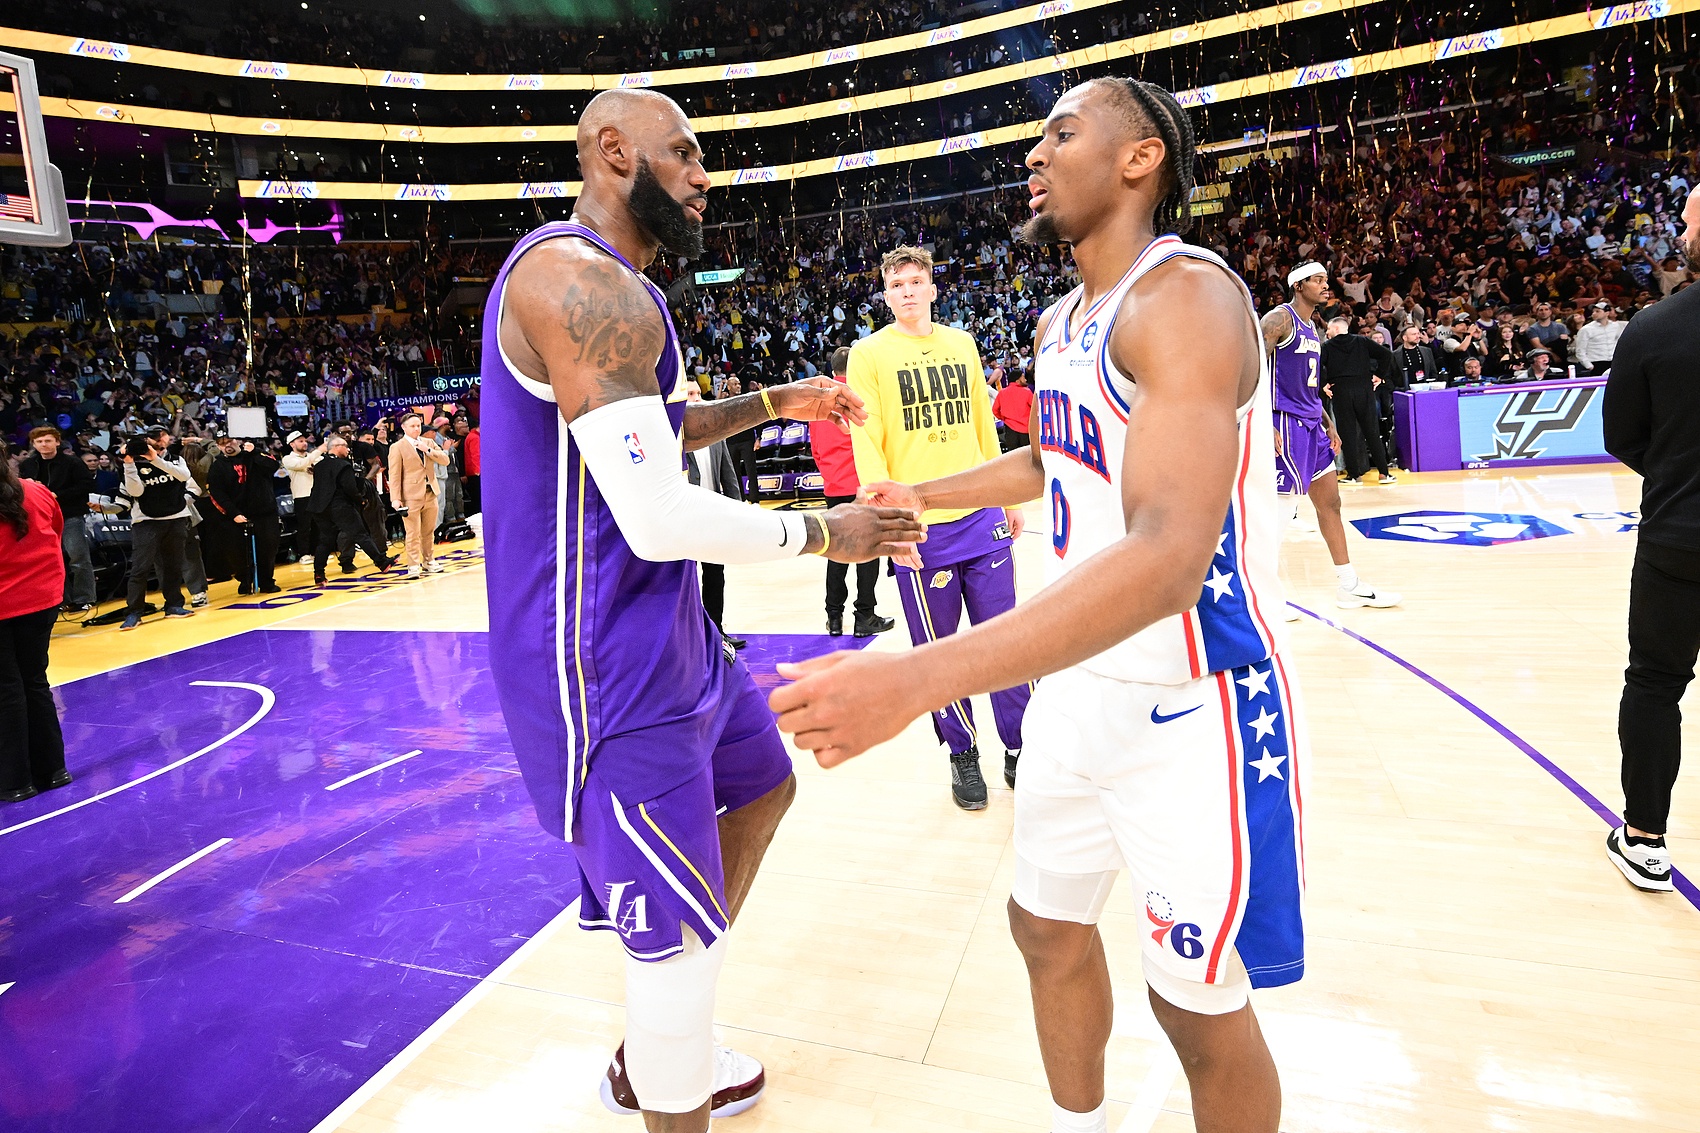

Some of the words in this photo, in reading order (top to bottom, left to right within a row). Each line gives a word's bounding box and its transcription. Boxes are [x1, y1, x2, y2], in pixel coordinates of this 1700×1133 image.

[1602, 2, 1663, 26] LAKERS
[76, 41, 124, 58] LAKERS
[1442, 36, 1495, 57] LAKERS
[245, 63, 284, 76] LAKERS
[1298, 65, 1347, 85] LAKERS
[385, 74, 420, 86] LAKERS
[1174, 91, 1211, 105] AKERS
[941, 137, 978, 153] LAKERS
[838, 154, 874, 170] LAKERS
[1512, 149, 1575, 165] crypto.com
[737, 169, 773, 183] LAKERS
[262, 181, 312, 198] LAKERS
[401, 183, 445, 200] LAKERS
[523, 182, 562, 197] LAKERS
[1307, 357, 1318, 387] 2
[897, 364, 969, 406] BLACK
[379, 399, 396, 407] 17x
[397, 393, 459, 406] CHAMPIONS
[903, 400, 969, 431] HISTORY
[1038, 390, 1111, 485] HILA
[1051, 477, 1071, 560] 0
[604, 881, 652, 939] LA
